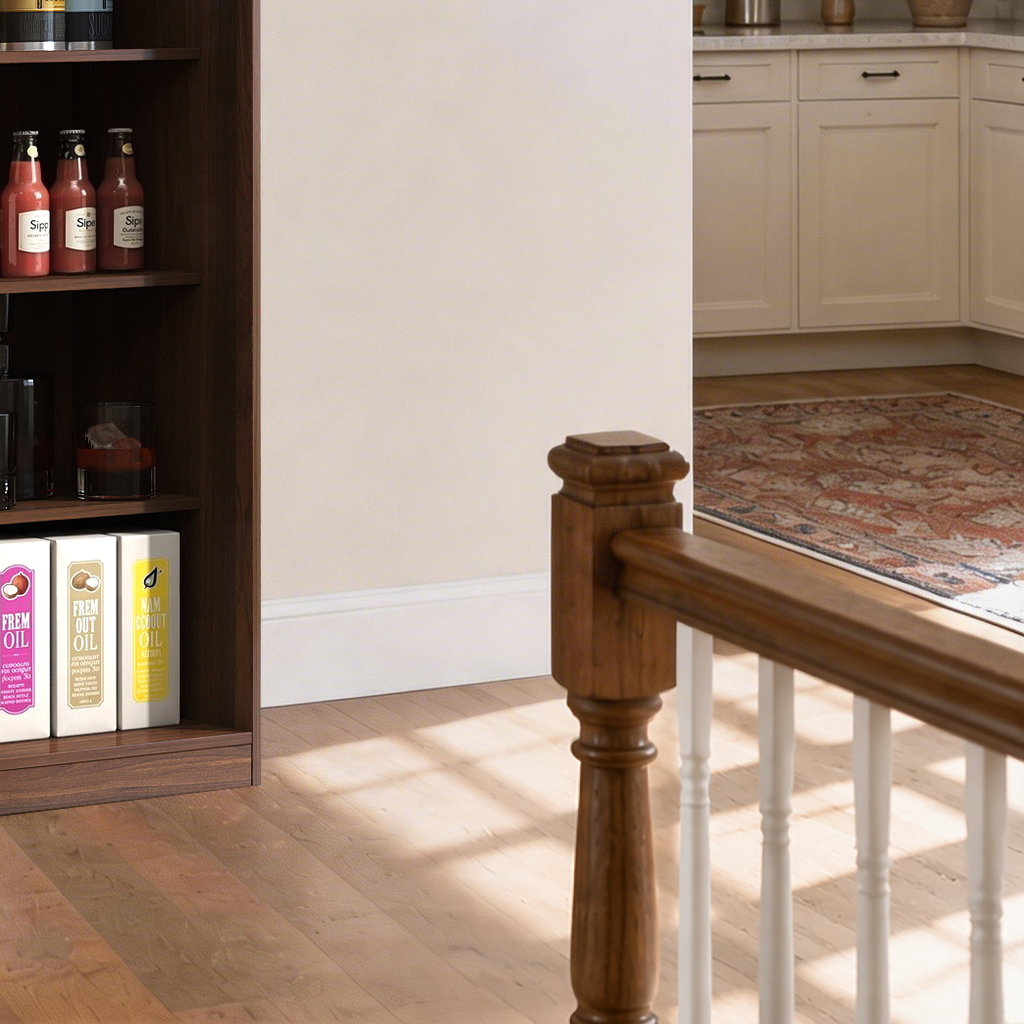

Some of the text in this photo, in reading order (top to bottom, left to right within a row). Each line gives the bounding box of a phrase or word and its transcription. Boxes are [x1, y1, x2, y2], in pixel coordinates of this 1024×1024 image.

[73, 599, 99, 617] FREM
[1, 612, 31, 630] FREM
[75, 617, 97, 634] OUT
[4, 630, 29, 650] OIL
[73, 634, 98, 652] OIL
[139, 631, 163, 648] OIL
